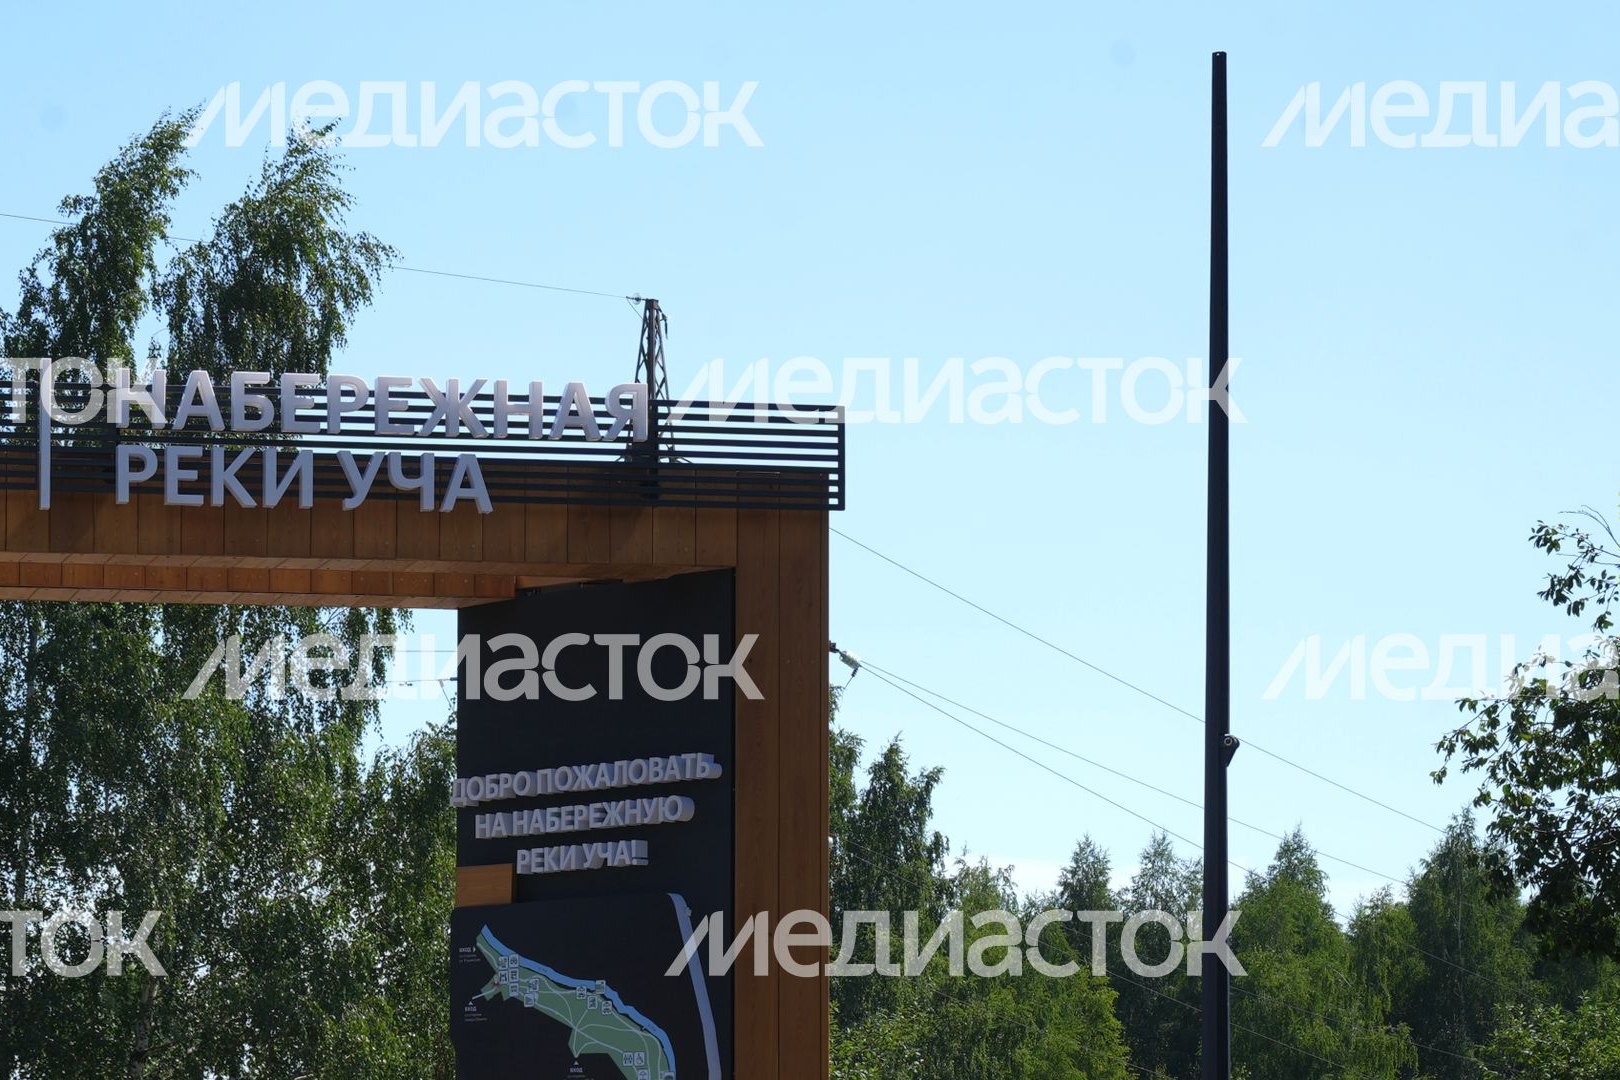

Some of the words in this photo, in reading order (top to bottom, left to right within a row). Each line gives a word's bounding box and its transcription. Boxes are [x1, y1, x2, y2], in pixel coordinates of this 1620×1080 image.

[116, 367, 648, 442] НАБЕРЕЖНАЯ
[116, 444, 314, 510] РЕКИ
[337, 449, 494, 514] УЧА
[450, 771, 536, 808] ДОБРО
[536, 752, 723, 795] ПОЖАЛОВАТЬ
[475, 811, 512, 839] НА
[512, 795, 695, 837] НАБЕРЕЖНУЮ
[516, 846, 582, 875] РЕКИ
[582, 839, 649, 869] УЧА!
